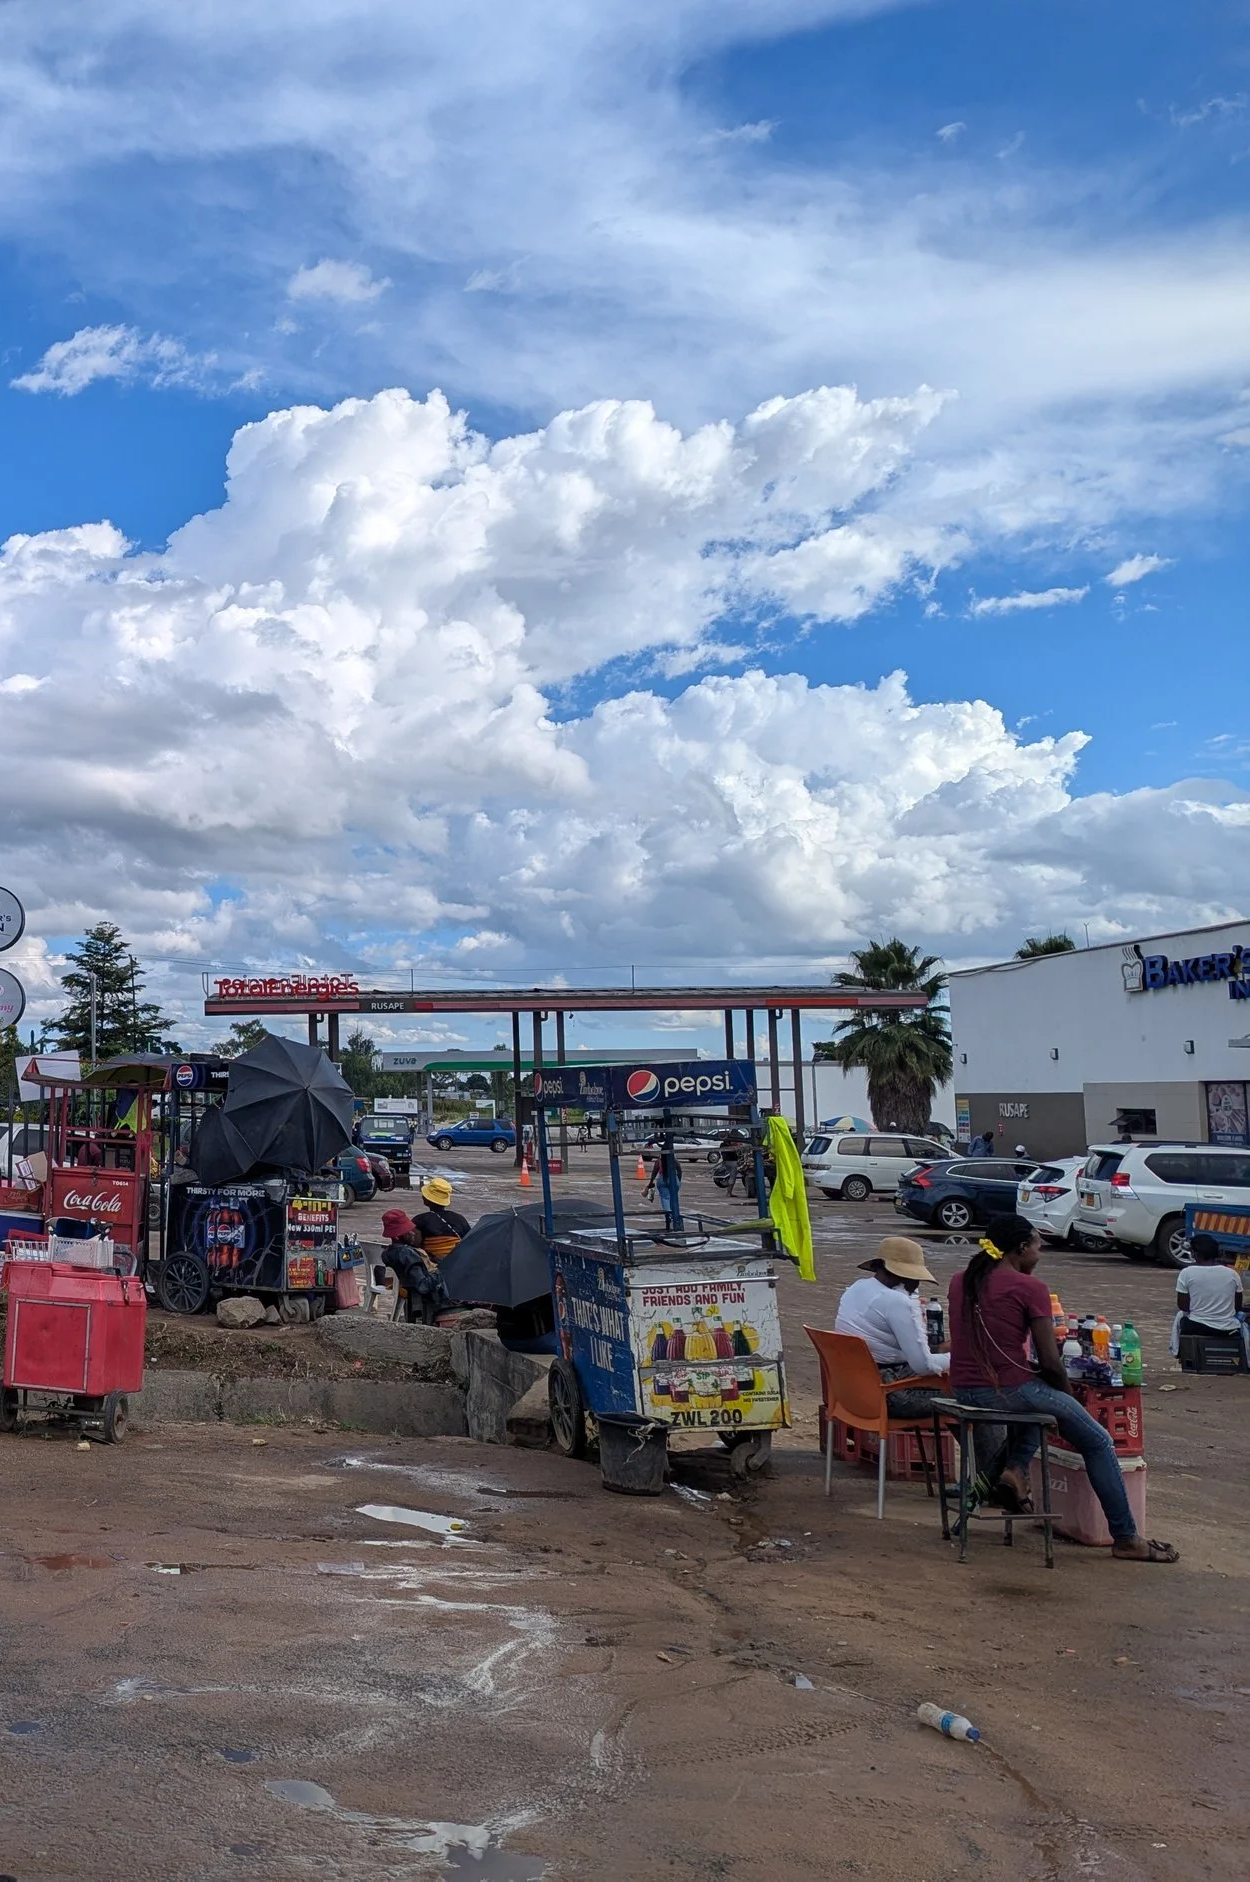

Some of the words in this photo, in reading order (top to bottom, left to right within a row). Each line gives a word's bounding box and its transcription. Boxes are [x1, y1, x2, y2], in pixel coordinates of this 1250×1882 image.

[1229, 980, 1250, 1000] IN
[371, 1002, 405, 1010] RUSAPE
[393, 1057, 417, 1065] zuva
[998, 1102, 1030, 1118] RUSAPE
[186, 1186, 216, 1195] THIRSTY
[217, 1188, 237, 1196] FOR
[238, 1189, 266, 1197] MORE
[297, 1212, 330, 1222] BENEFITS
[324, 1225, 336, 1233] PET
[642, 1294, 692, 1307] FRIENDS
[695, 1294, 719, 1305] AND
[722, 1292, 745, 1304] FUN
[599, 1305, 625, 1342] WHAT
[594, 1337, 615, 1373] LIKE
[669, 1410, 707, 1427] ZWL
[709, 1408, 743, 1425] 200
